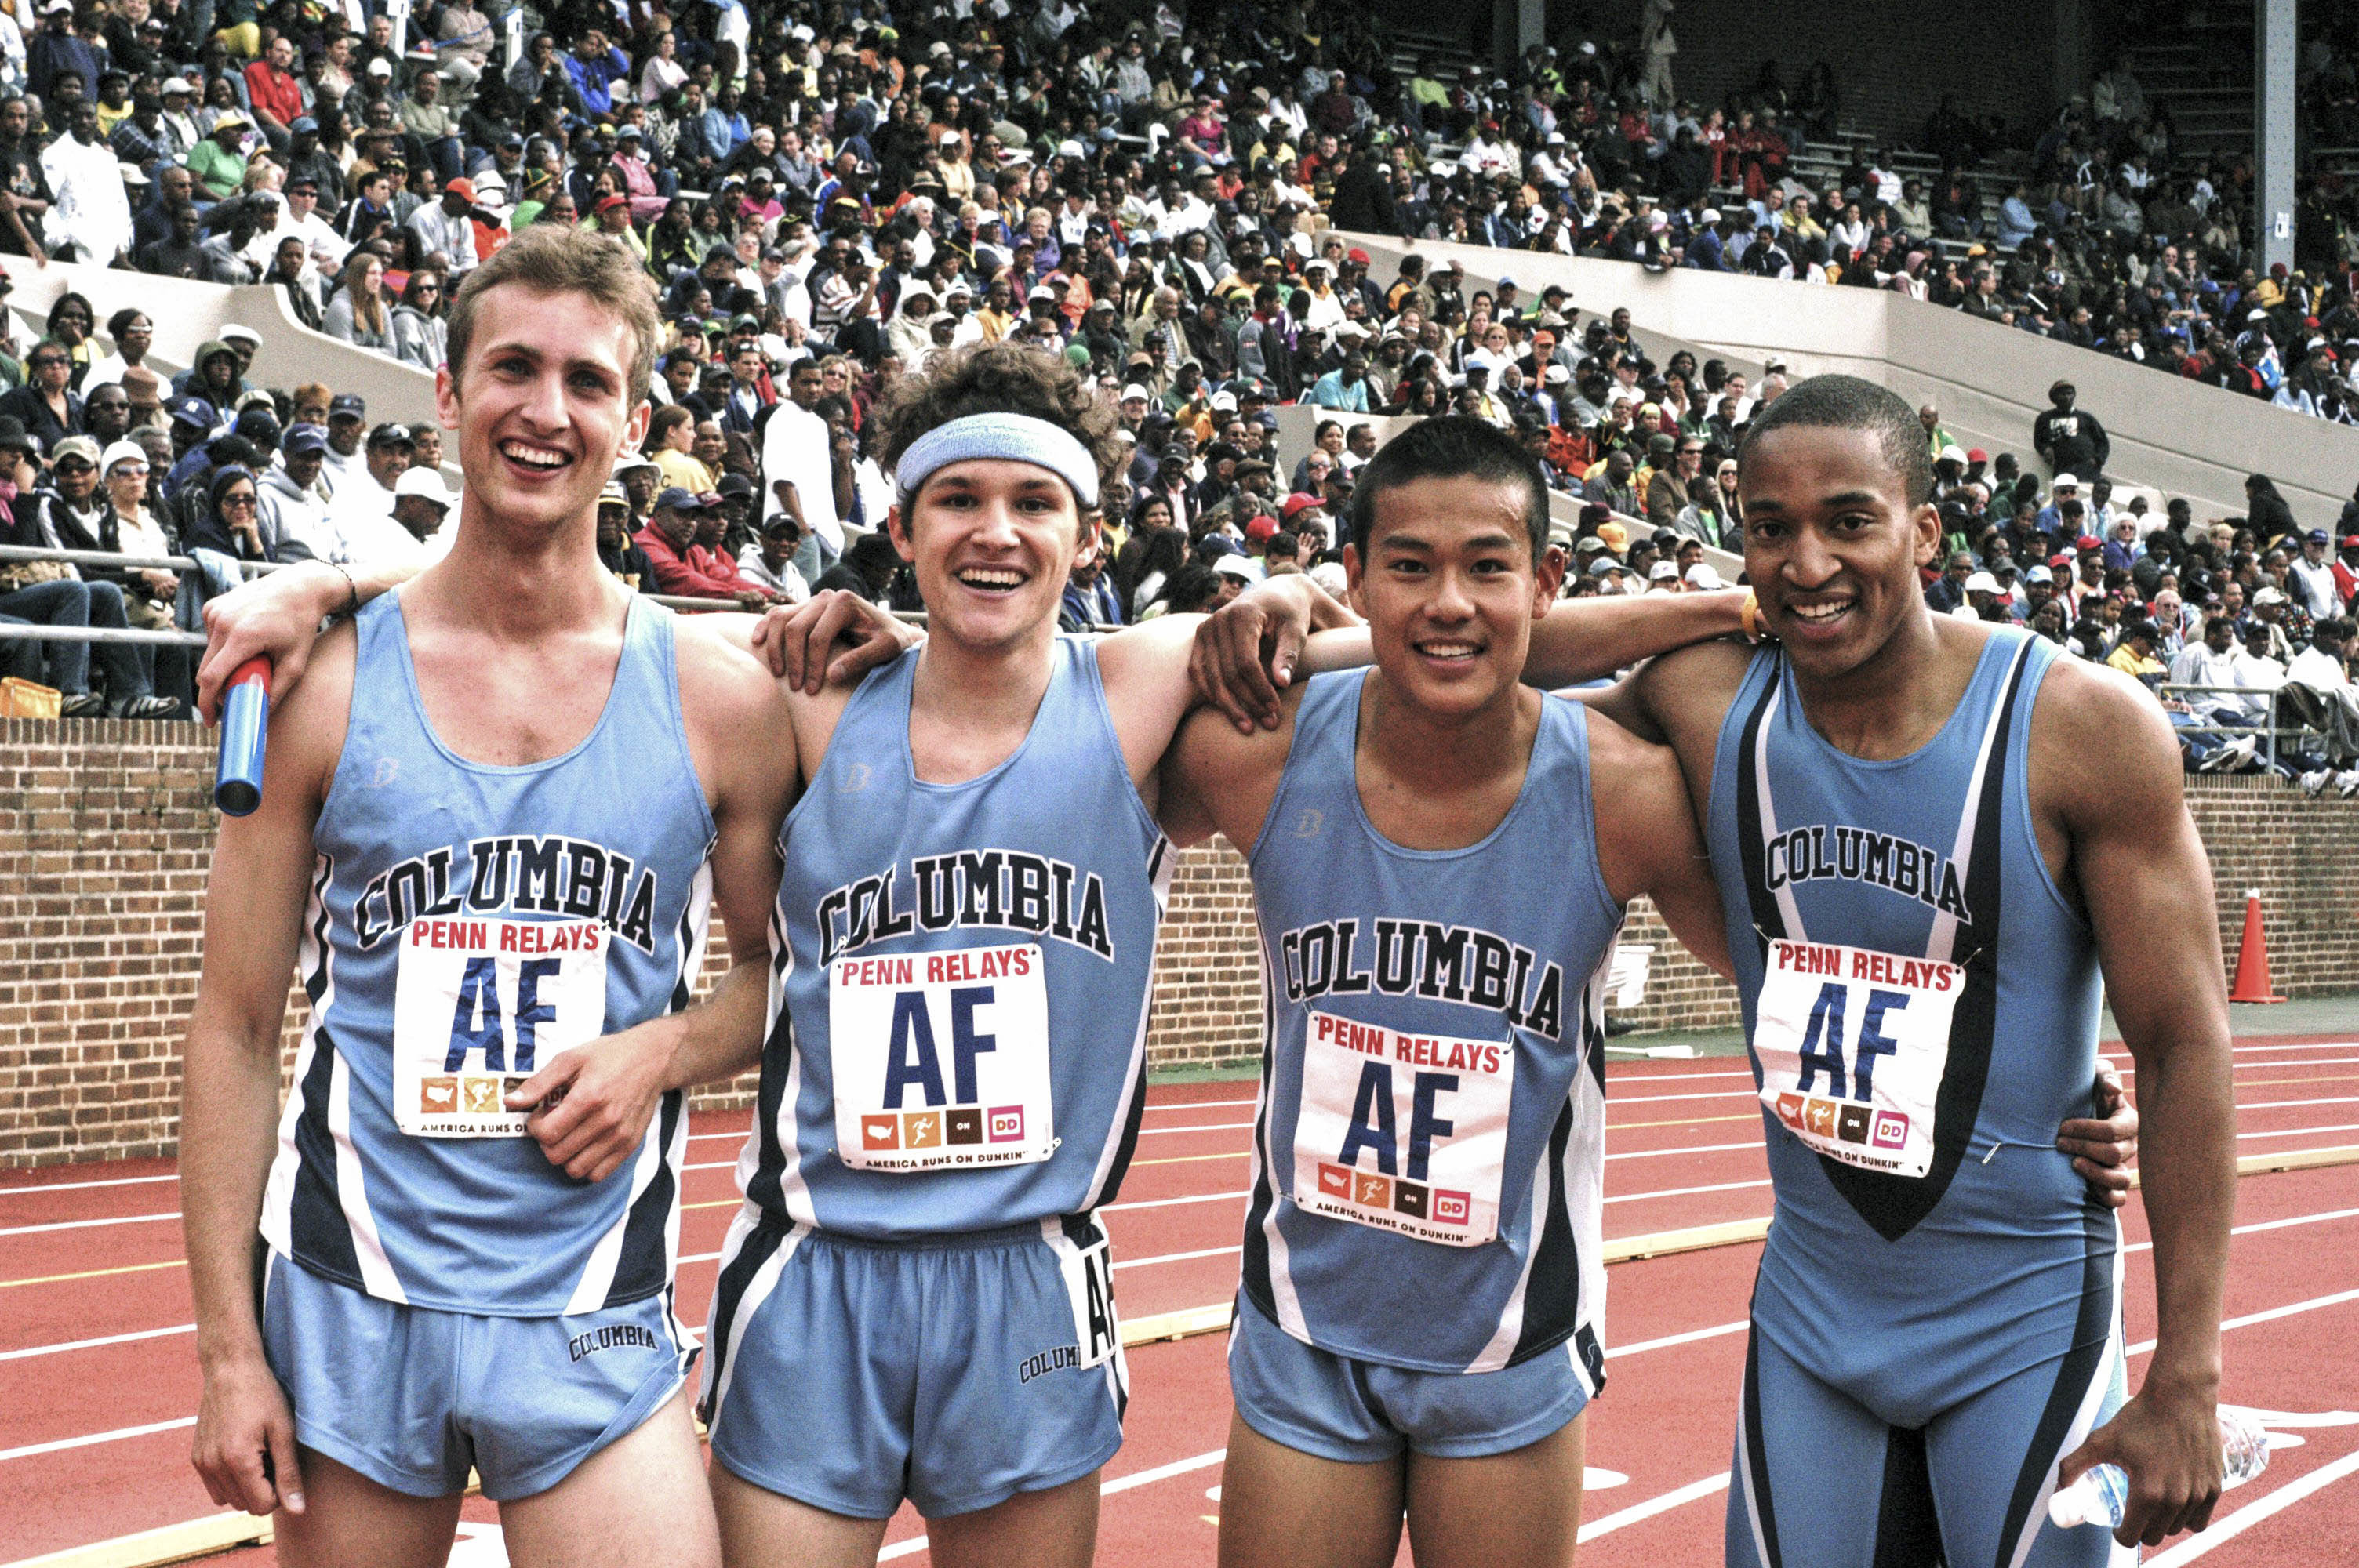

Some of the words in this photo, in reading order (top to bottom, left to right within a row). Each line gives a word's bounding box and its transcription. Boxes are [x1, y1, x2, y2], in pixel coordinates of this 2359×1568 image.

[1765, 825, 1972, 925] COLUMBIA
[354, 835, 656, 956] COLUMBIA
[816, 848, 1114, 971] COLUMBIA
[412, 920, 487, 950] PENN
[500, 923, 600, 953] RELAYS
[841, 958, 913, 985] PENN
[927, 949, 1030, 983] RELAYS
[1281, 917, 1563, 1042] COLUMBIA
[1779, 943, 1841, 976] PENN
[1852, 953, 1953, 992] RELAYS
[443, 956, 562, 1073] AF
[882, 985, 997, 1109] AF
[1318, 1015, 1384, 1056] PENN
[1396, 1036, 1500, 1073] RELAYS
[1796, 982, 1911, 1102] AF
[421, 1124, 475, 1133] AMERICA
[956, 1122, 970, 1131] ON
[995, 1119, 1017, 1131] DD
[1338, 1060, 1459, 1181] AF
[1881, 1124, 1902, 1138] DD
[922, 1156, 951, 1166] RUNS
[956, 1155, 973, 1163] ON
[1845, 1152, 1858, 1162] ON
[1316, 1202, 1365, 1221] AMERICA
[1369, 1215, 1397, 1229] RUNS
[1401, 1223, 1416, 1234] ON
[1404, 1194, 1417, 1203] ON
[1441, 1201, 1463, 1214] DD
[568, 1324, 659, 1363] COLUMBIA
[1019, 1345, 1100, 1385] COLUM
